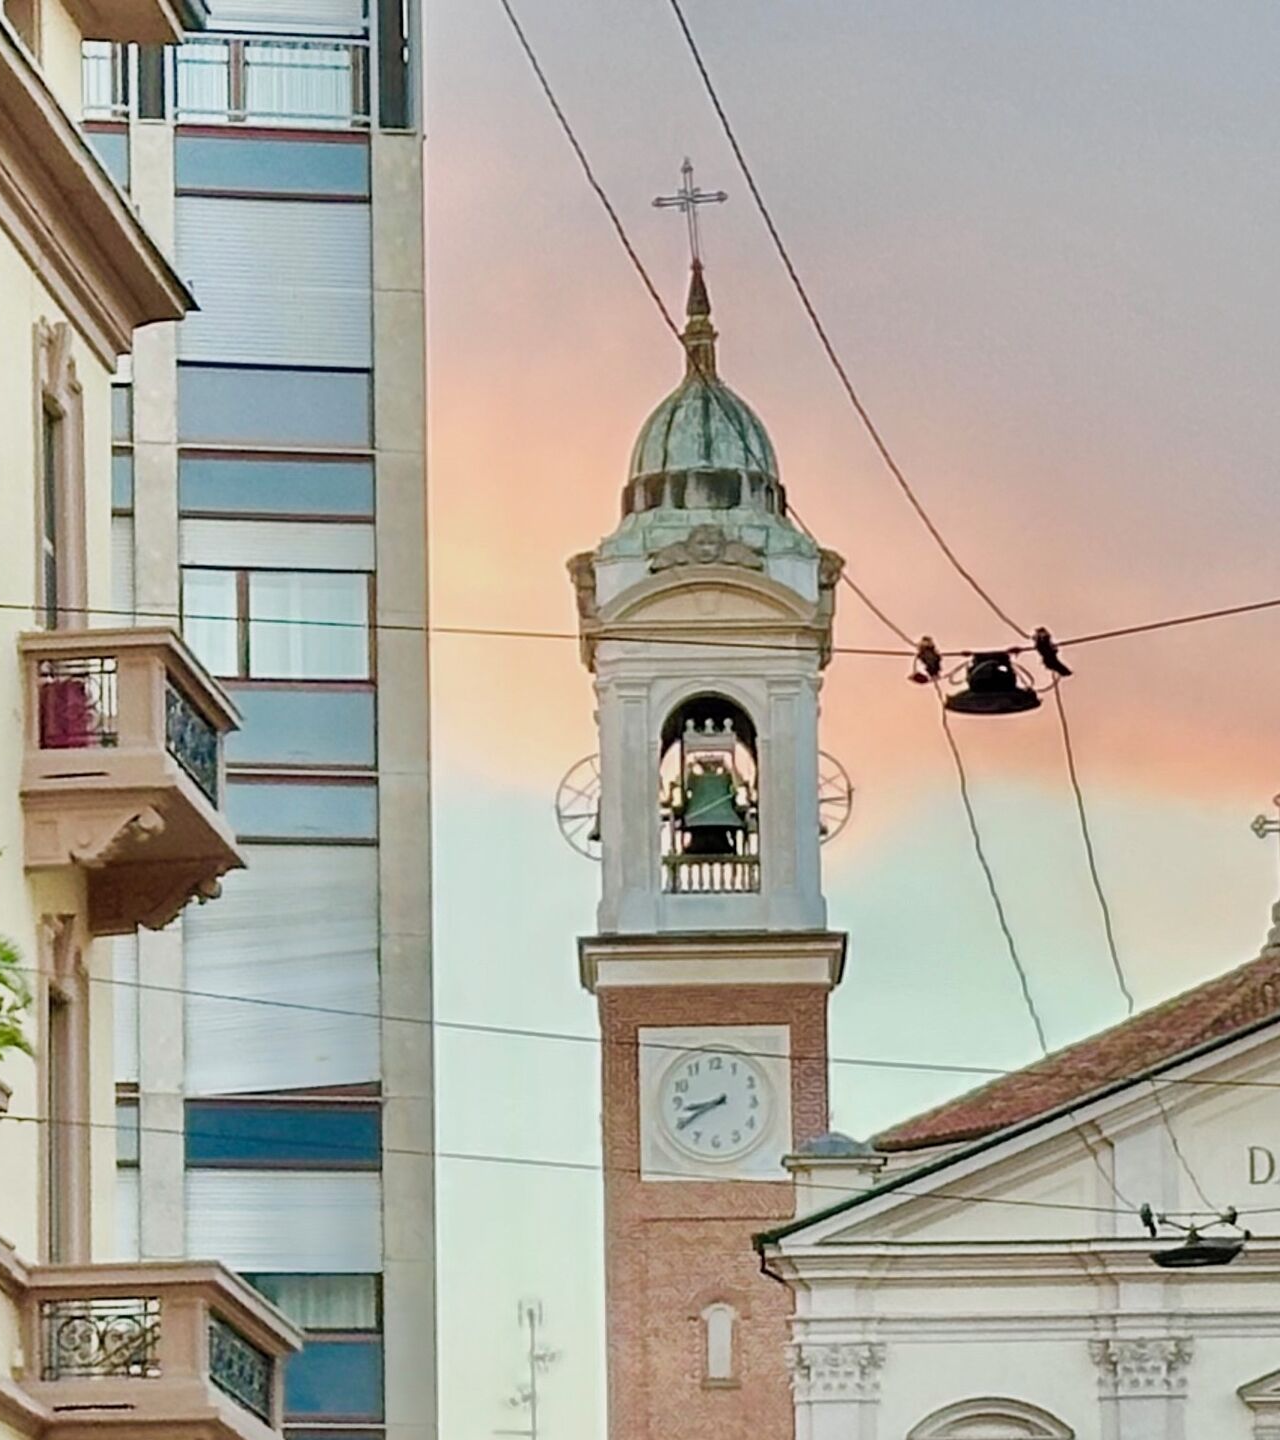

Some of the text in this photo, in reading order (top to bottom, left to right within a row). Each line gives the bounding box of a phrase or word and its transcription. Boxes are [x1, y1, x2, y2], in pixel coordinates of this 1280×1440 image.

[687, 1062, 700, 1076] 11
[708, 1057, 723, 1070] 12
[731, 1062, 738, 1075] 1
[674, 1079, 689, 1093] 10
[746, 1076, 756, 1089] 2
[672, 1096, 683, 1110] 9
[749, 1096, 759, 1109] 3
[745, 1115, 755, 1130] 4
[692, 1131, 702, 1144] 7
[711, 1135, 721, 1149] 6
[732, 1131, 742, 1144] 5
